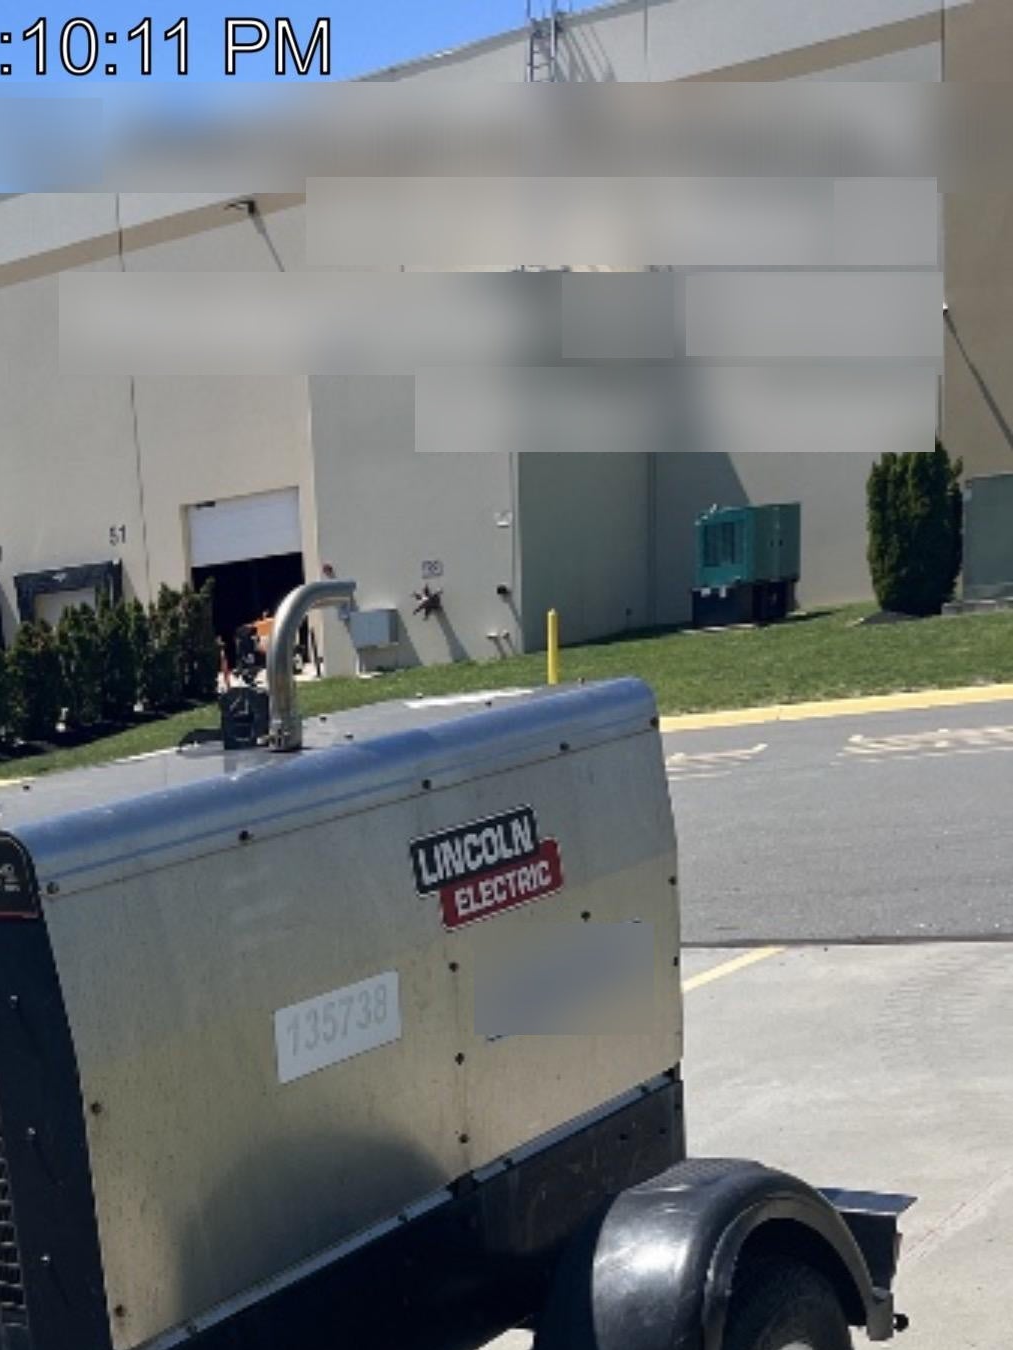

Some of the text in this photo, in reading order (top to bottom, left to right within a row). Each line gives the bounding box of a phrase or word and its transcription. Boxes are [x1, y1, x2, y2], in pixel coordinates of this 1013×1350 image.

[417, 815, 535, 886] LINCOLN
[454, 861, 552, 917] ELECTRIC
[287, 984, 389, 1057] 135738
